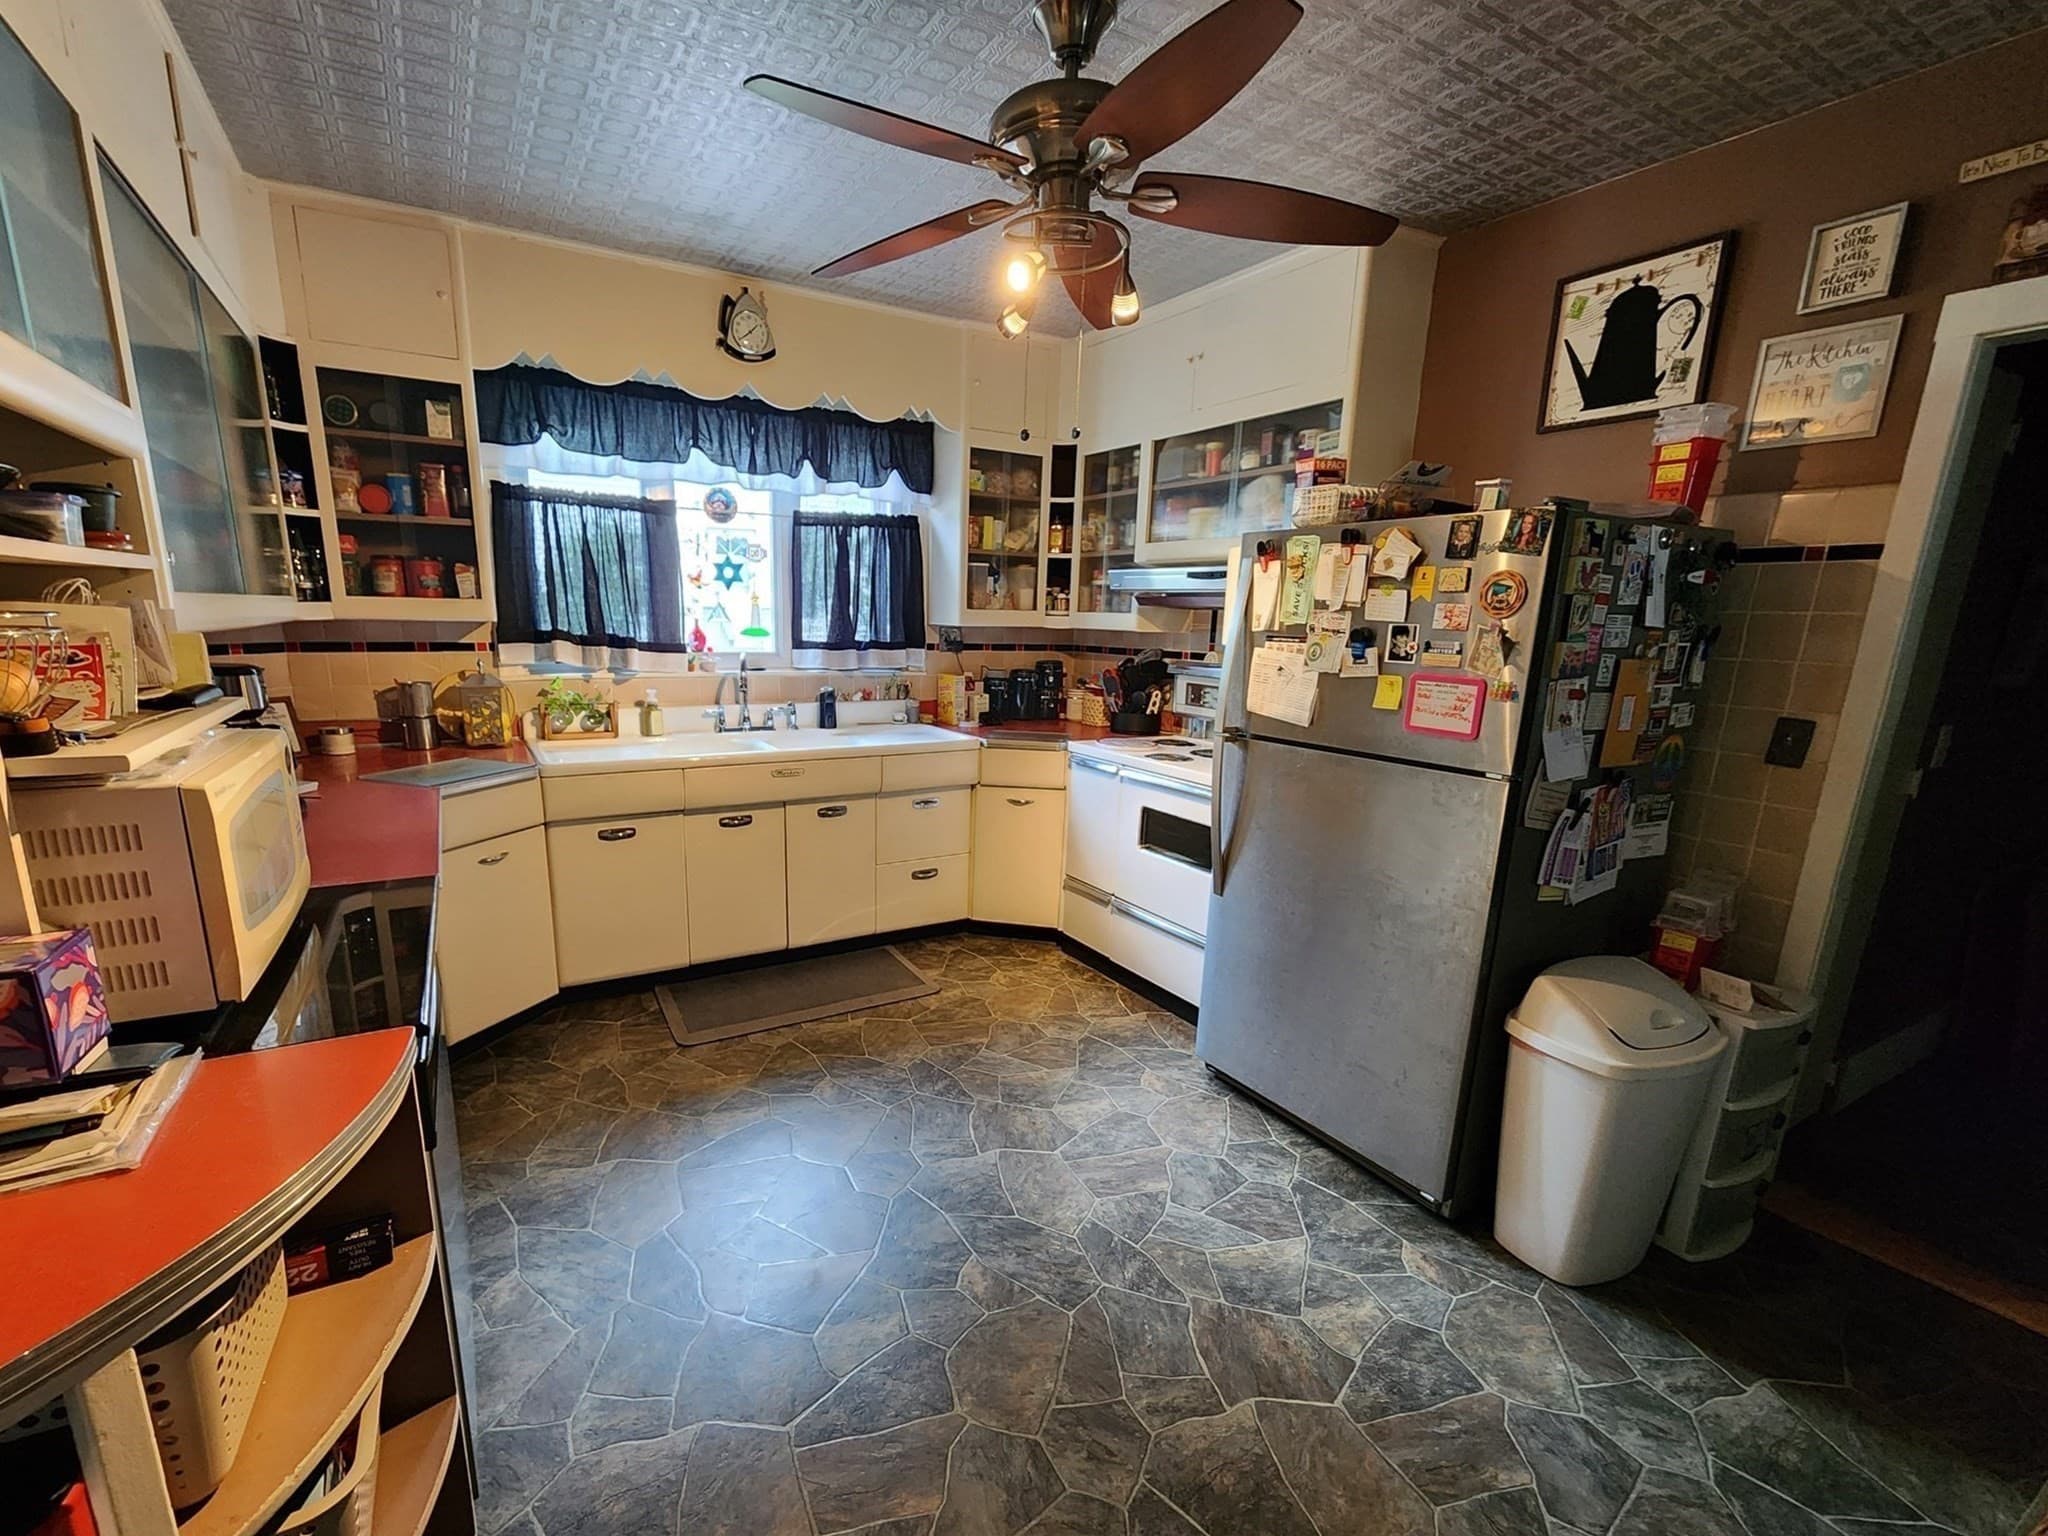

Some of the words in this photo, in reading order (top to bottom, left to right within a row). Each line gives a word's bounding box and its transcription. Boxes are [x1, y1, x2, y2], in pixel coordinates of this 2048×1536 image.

[2015, 147, 2031, 165] To
[1843, 224, 1873, 240] GOOD
[1834, 234, 1879, 252] FRIENDS
[1819, 266, 1876, 287] always
[1820, 280, 1858, 300] THERE
[1773, 349, 1803, 376] The
[1805, 339, 1877, 369] Kitchen
[1291, 590, 1302, 617] SAVE
